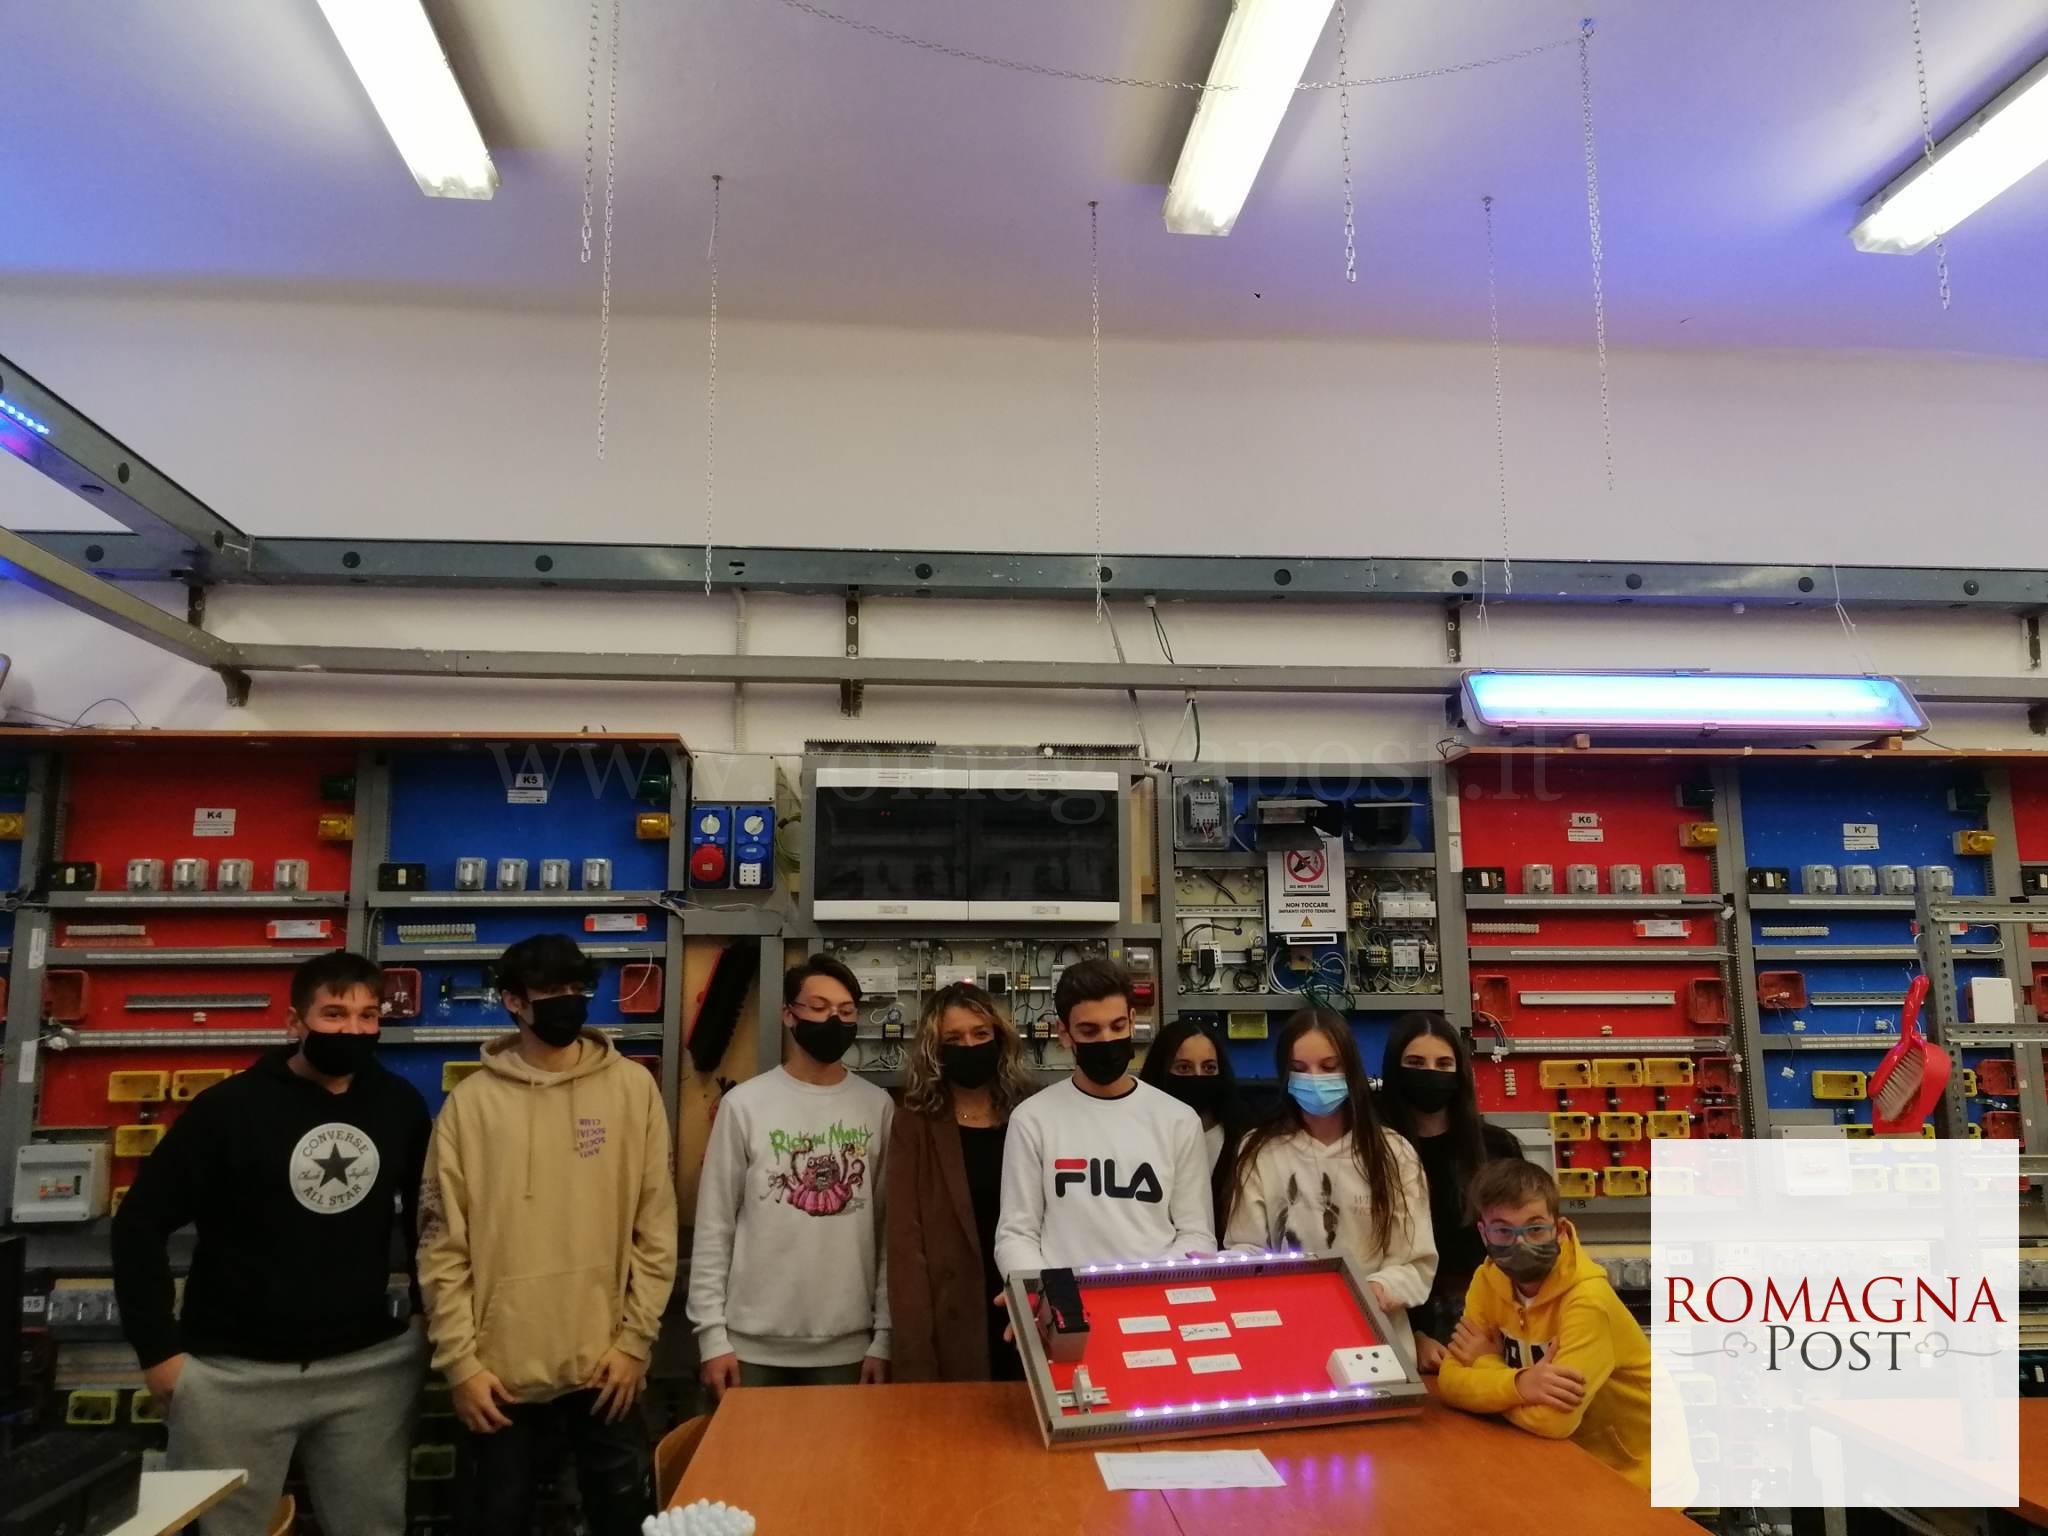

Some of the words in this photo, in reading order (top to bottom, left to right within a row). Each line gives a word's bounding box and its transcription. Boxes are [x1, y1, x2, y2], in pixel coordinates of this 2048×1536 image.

[523, 775, 538, 784] K5
[207, 811, 222, 819] K4
[1578, 816, 1592, 824] K6
[1854, 826, 1867, 834] K7
[303, 1130, 369, 1157] CONVERSE
[1055, 1158, 1163, 1203] FILA
[303, 1186, 325, 1204] ALL
[329, 1183, 362, 1206] STAR
